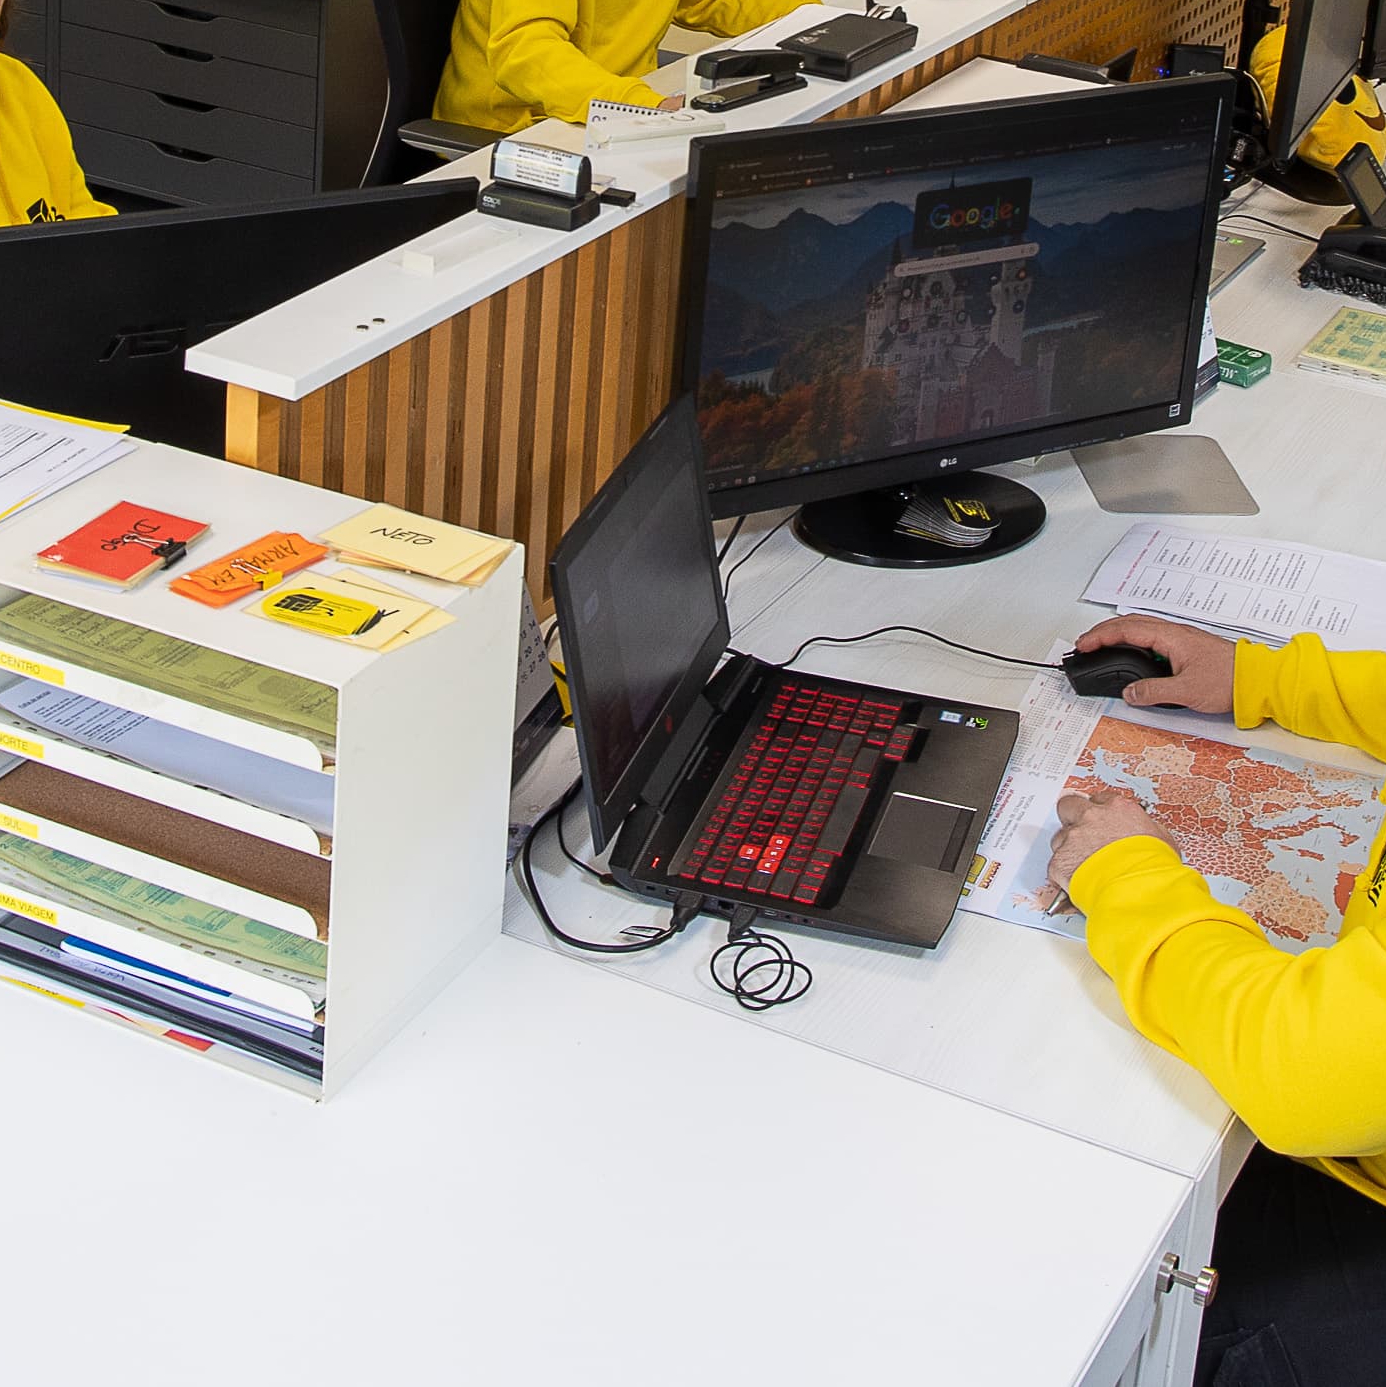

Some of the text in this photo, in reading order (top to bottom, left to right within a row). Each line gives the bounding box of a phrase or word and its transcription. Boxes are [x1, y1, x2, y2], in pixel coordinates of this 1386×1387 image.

[930, 198, 1012, 229] Google
[369, 528, 436, 544] NETO
[0, 654, 40, 675] CENTRO
[3, 816, 22, 831] SUL
[18, 899, 55, 922] VIAGEM
